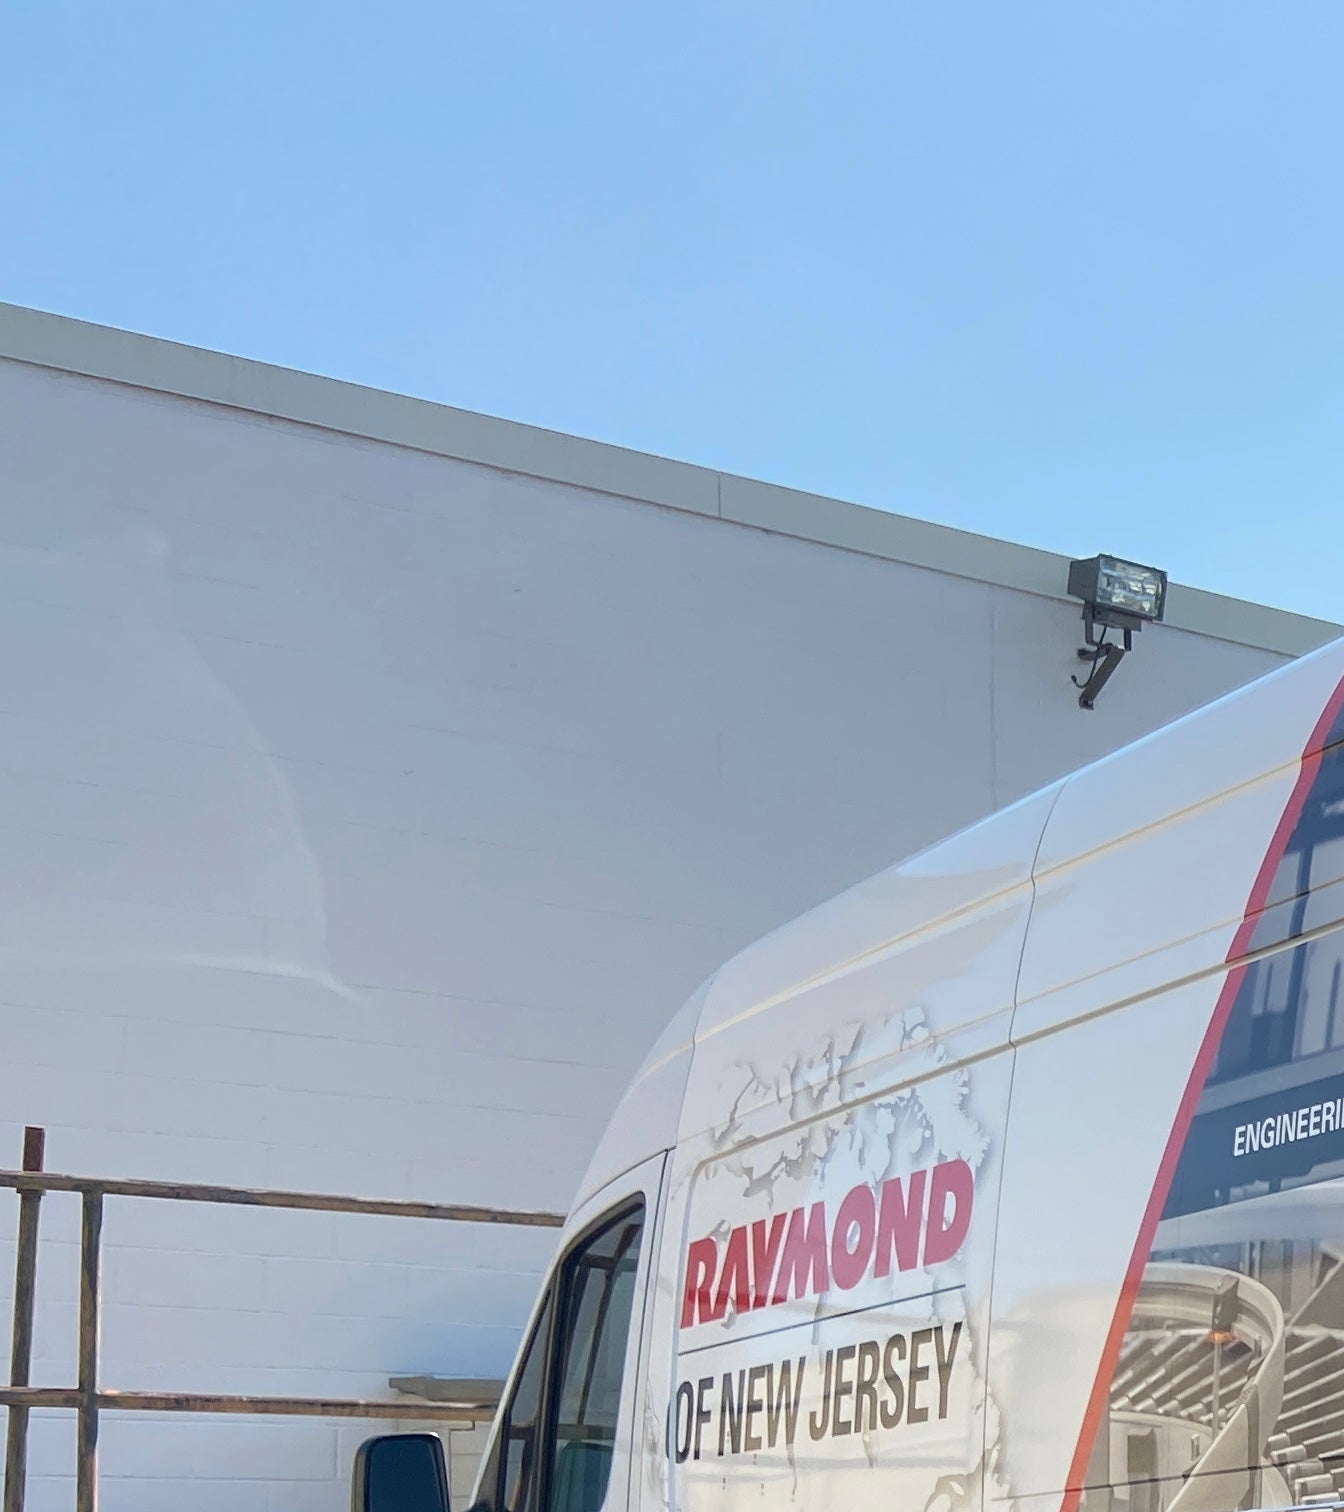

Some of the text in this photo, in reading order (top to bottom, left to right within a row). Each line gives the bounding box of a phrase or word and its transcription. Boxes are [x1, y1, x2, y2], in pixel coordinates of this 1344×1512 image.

[680, 1159, 975, 1330] RAYMOND
[667, 1322, 963, 1464] OF NEW JERSEY
